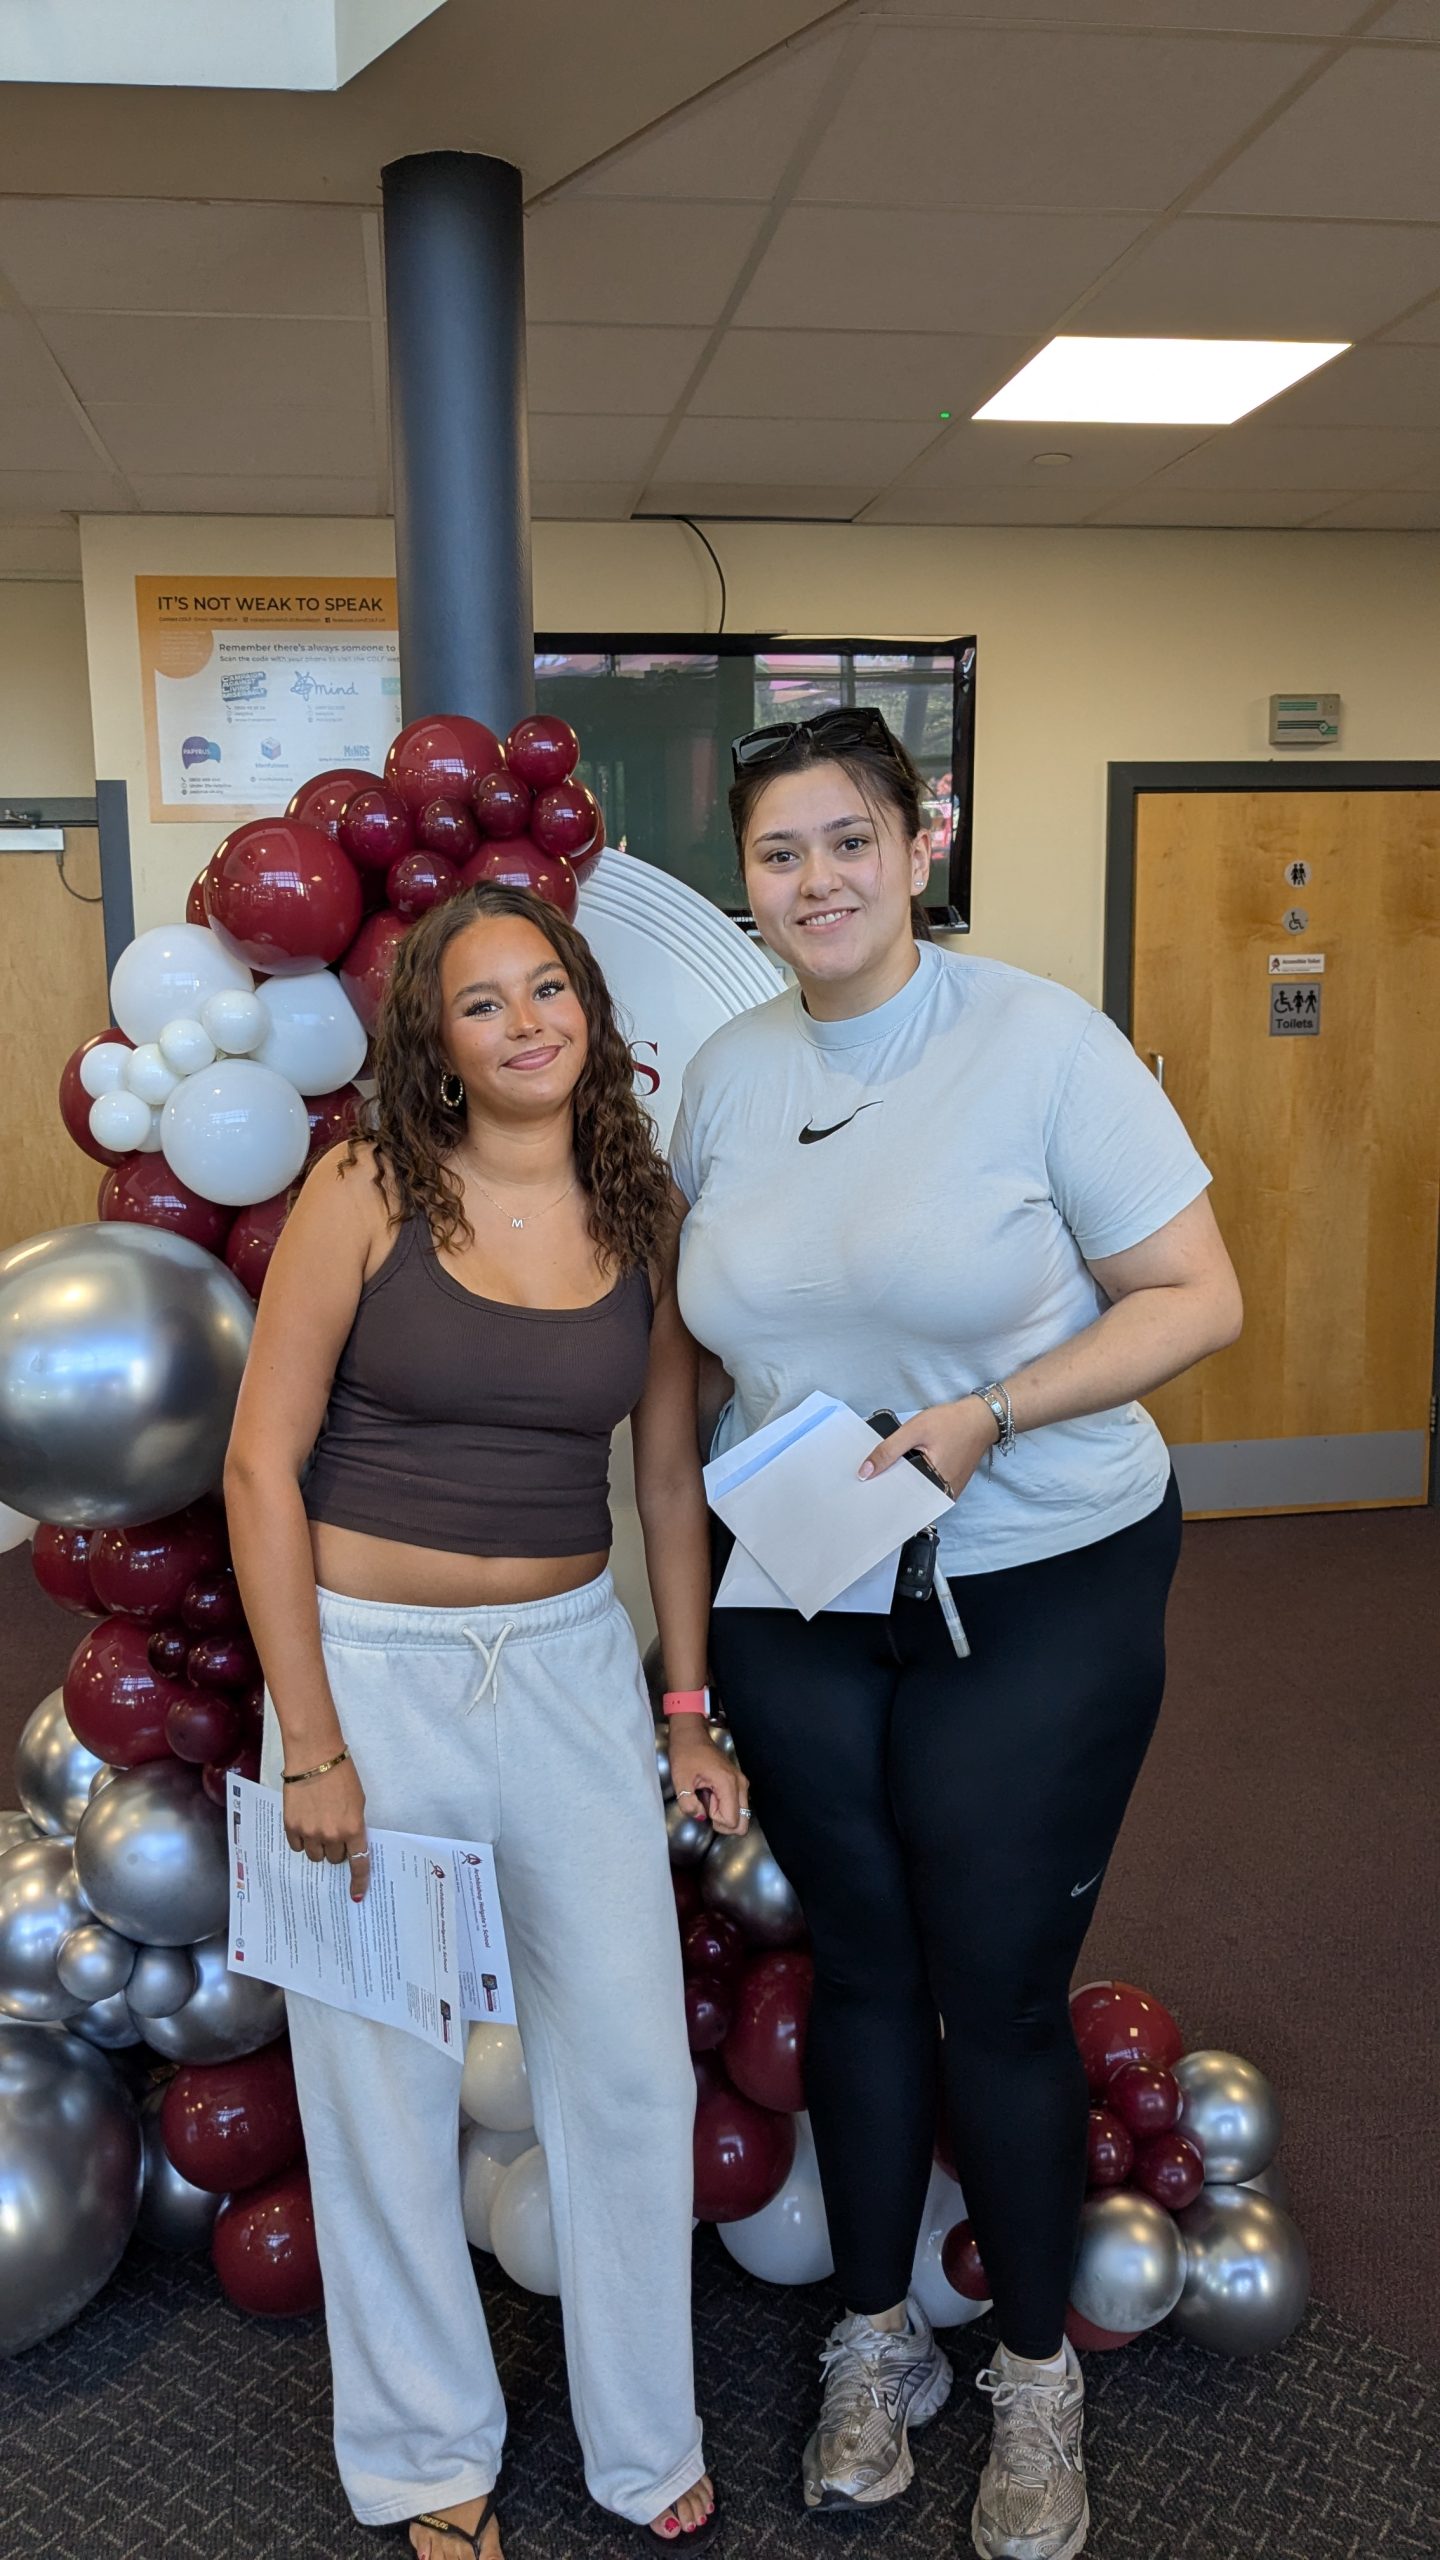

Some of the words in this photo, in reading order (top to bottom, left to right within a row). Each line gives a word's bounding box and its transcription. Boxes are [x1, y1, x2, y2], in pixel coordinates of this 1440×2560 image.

[158, 596, 189, 611] IT'S
[194, 597, 231, 611] NOT
[236, 597, 291, 611] WEAK
[296, 598, 320, 612] TO
[325, 598, 383, 612] SPEAK
[219, 643, 271, 652] Remember
[273, 643, 306, 652] there's
[307, 644, 340, 654] always
[1275, 1018, 1313, 1029] Toilets
[511, 1218, 524, 1229] M
[474, 1868, 484, 1900] Archbishop
[478, 1902, 488, 1928] Holgate's
[482, 1929, 492, 1948] School
